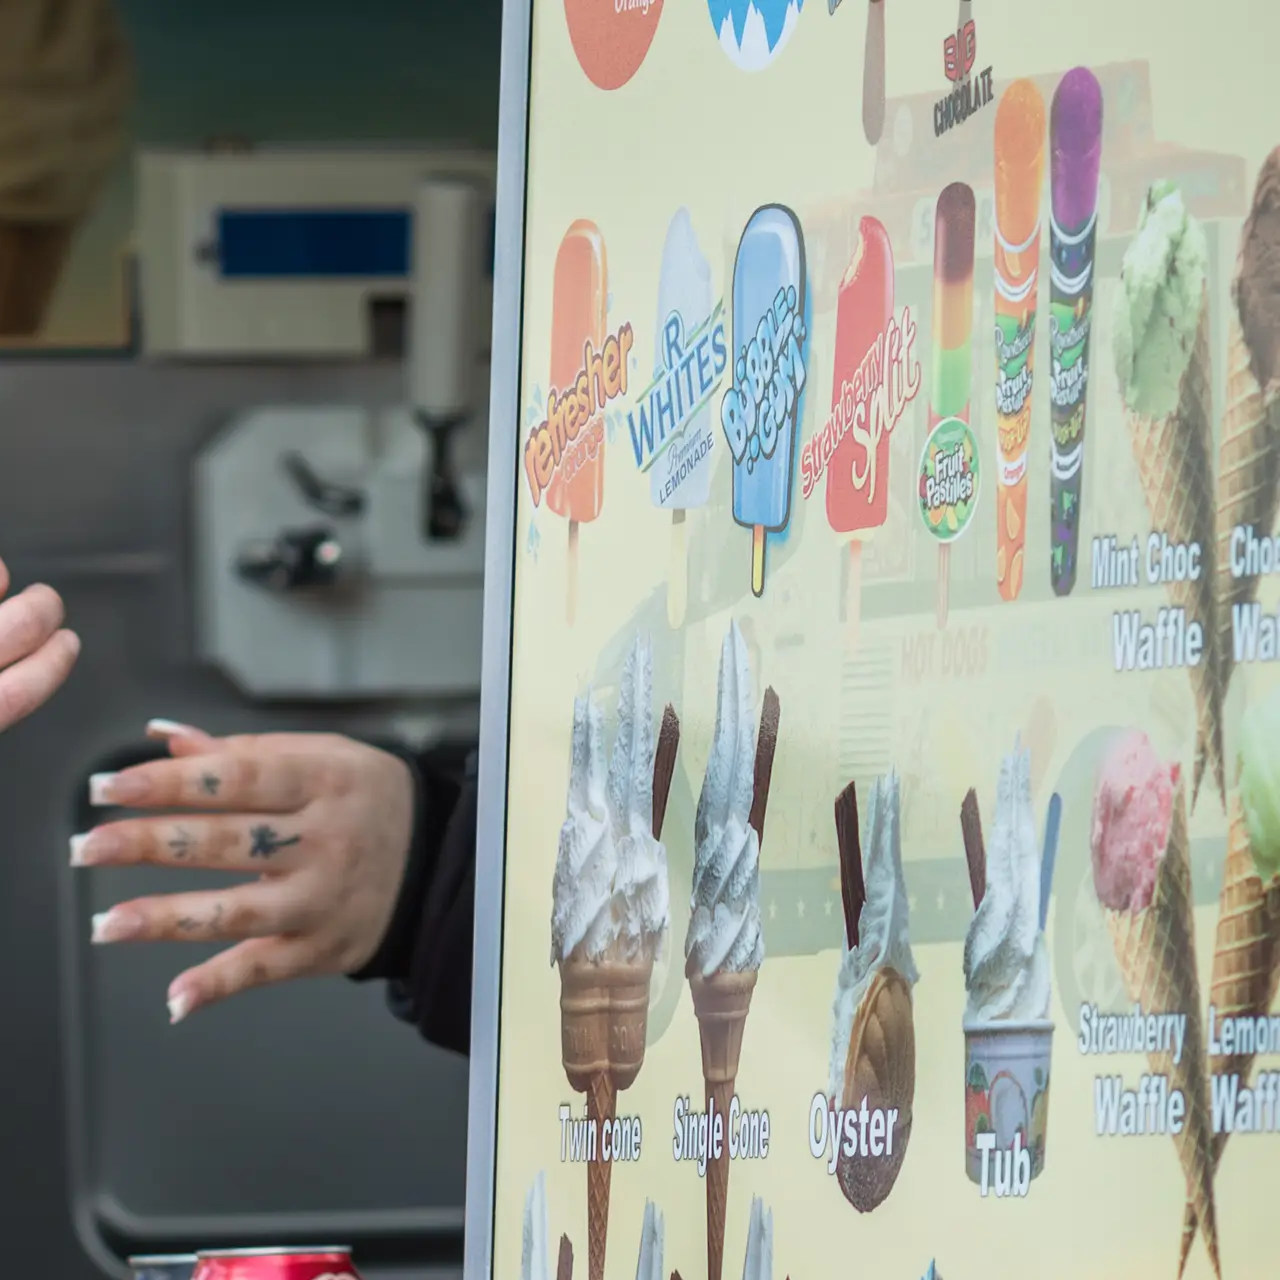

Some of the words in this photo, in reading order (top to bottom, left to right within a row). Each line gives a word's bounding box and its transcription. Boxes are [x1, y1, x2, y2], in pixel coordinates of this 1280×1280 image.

[944, 19, 976, 82] BIG
[933, 65, 994, 138] CHOCOLATE
[627, 324, 727, 468] WHITES
[802, 332, 883, 500] Strawberry
[851, 305, 921, 504] Split
[659, 431, 714, 504] LEMONADE
[926, 471, 973, 509] Pastilles
[934, 442, 965, 481] Fruit
[1092, 536, 1139, 589] Mint
[1145, 531, 1202, 584] Choc
[1112, 607, 1204, 671] Waffle
[1078, 1003, 1186, 1064] Strawberry
[559, 1104, 597, 1162] Twin
[601, 1115, 642, 1162] cone
[809, 1092, 899, 1175] Oyster
[1094, 1075, 1185, 1136] Waffle
[1210, 1070, 1280, 1135] Waff
[673, 1096, 723, 1178] Single
[728, 1094, 770, 1159] Cone
[976, 1132, 1031, 1197] Tub
